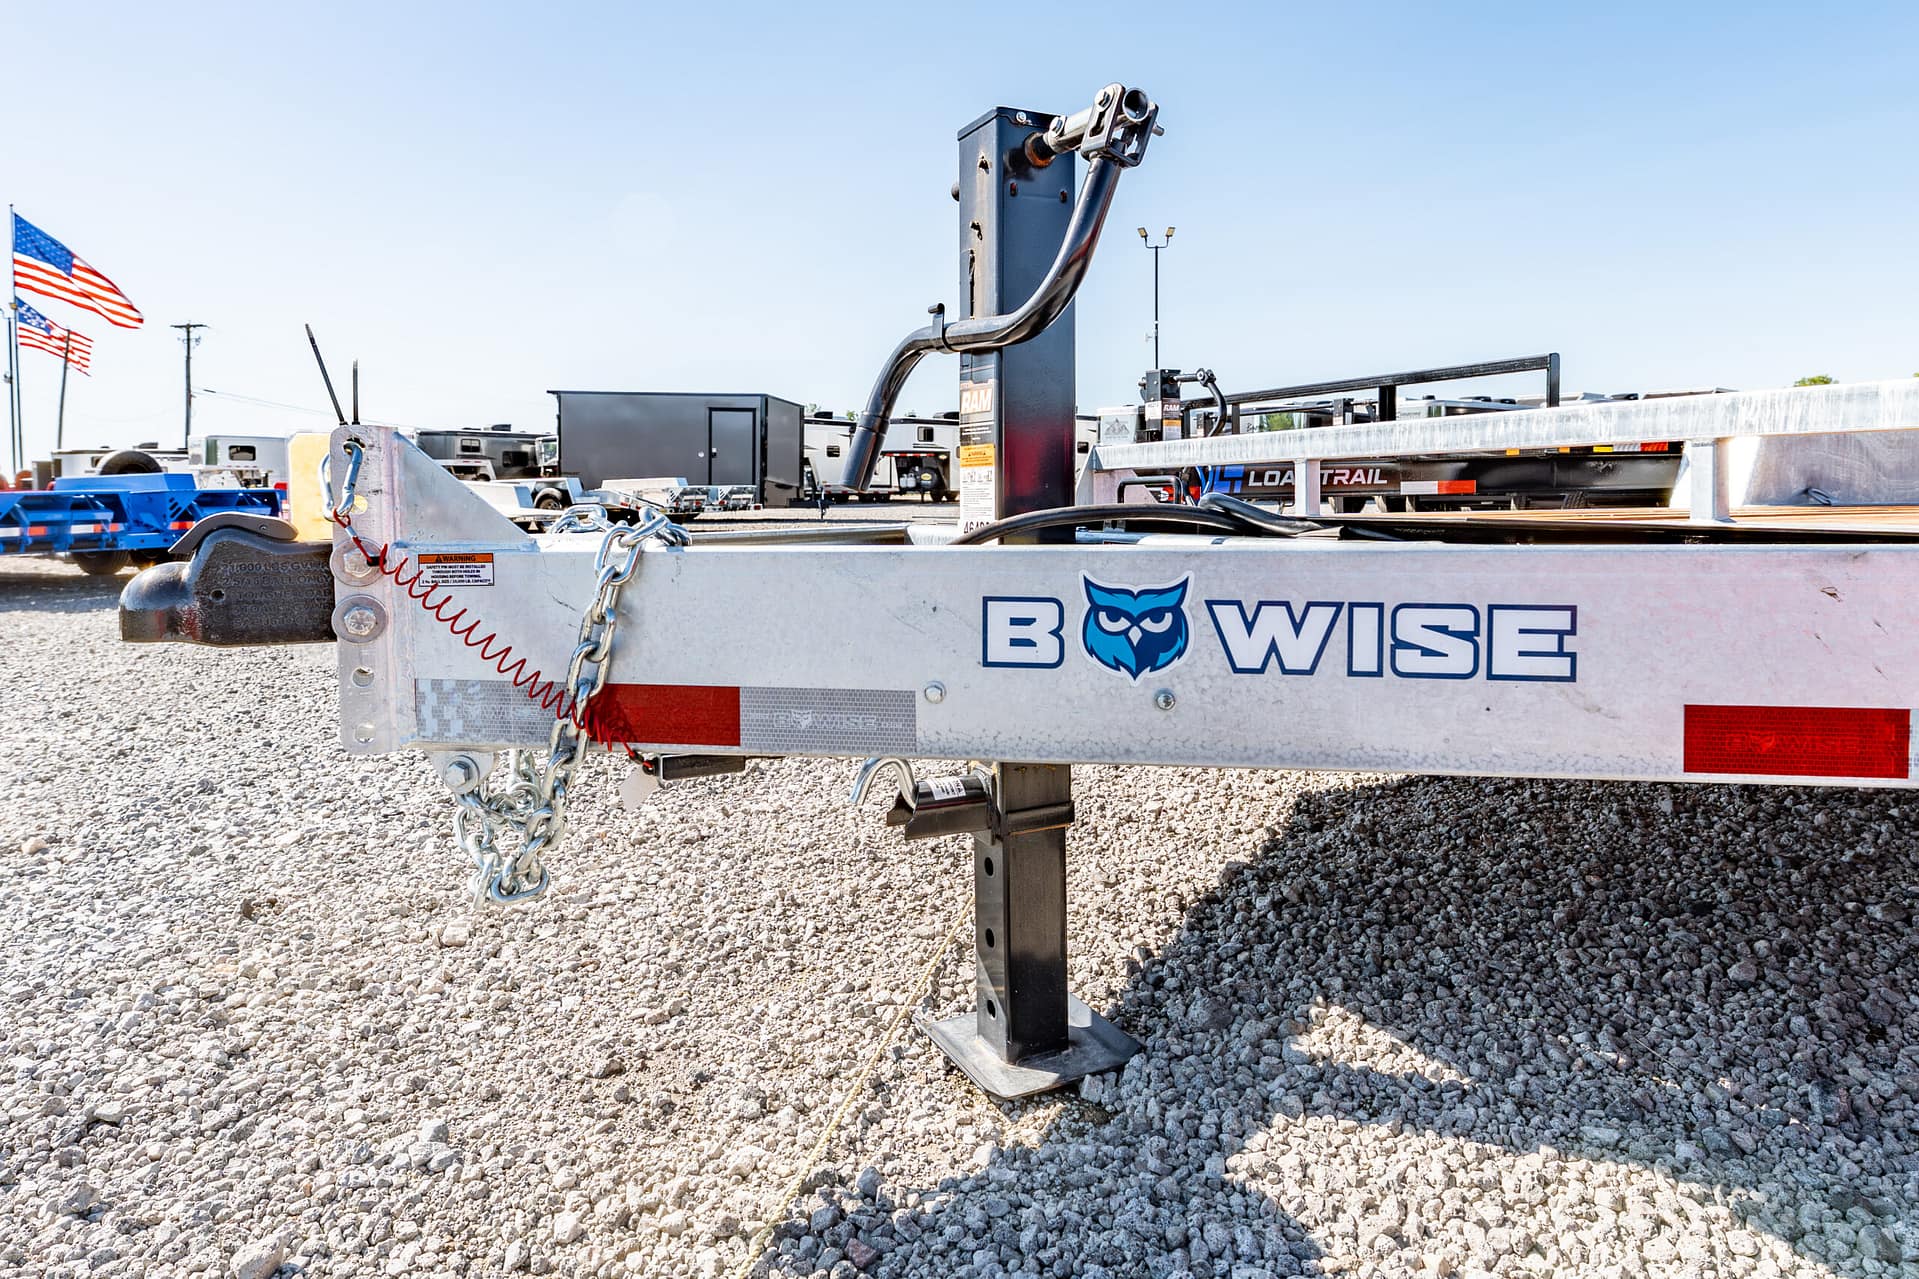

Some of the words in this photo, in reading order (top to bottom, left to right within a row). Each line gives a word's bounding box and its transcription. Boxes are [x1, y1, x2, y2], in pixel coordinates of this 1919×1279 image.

[961, 388, 992, 414] RAM
[1163, 404, 1180, 412] RAM
[1248, 470, 1296, 487] LOA
[1319, 468, 1388, 486] TRAIL
